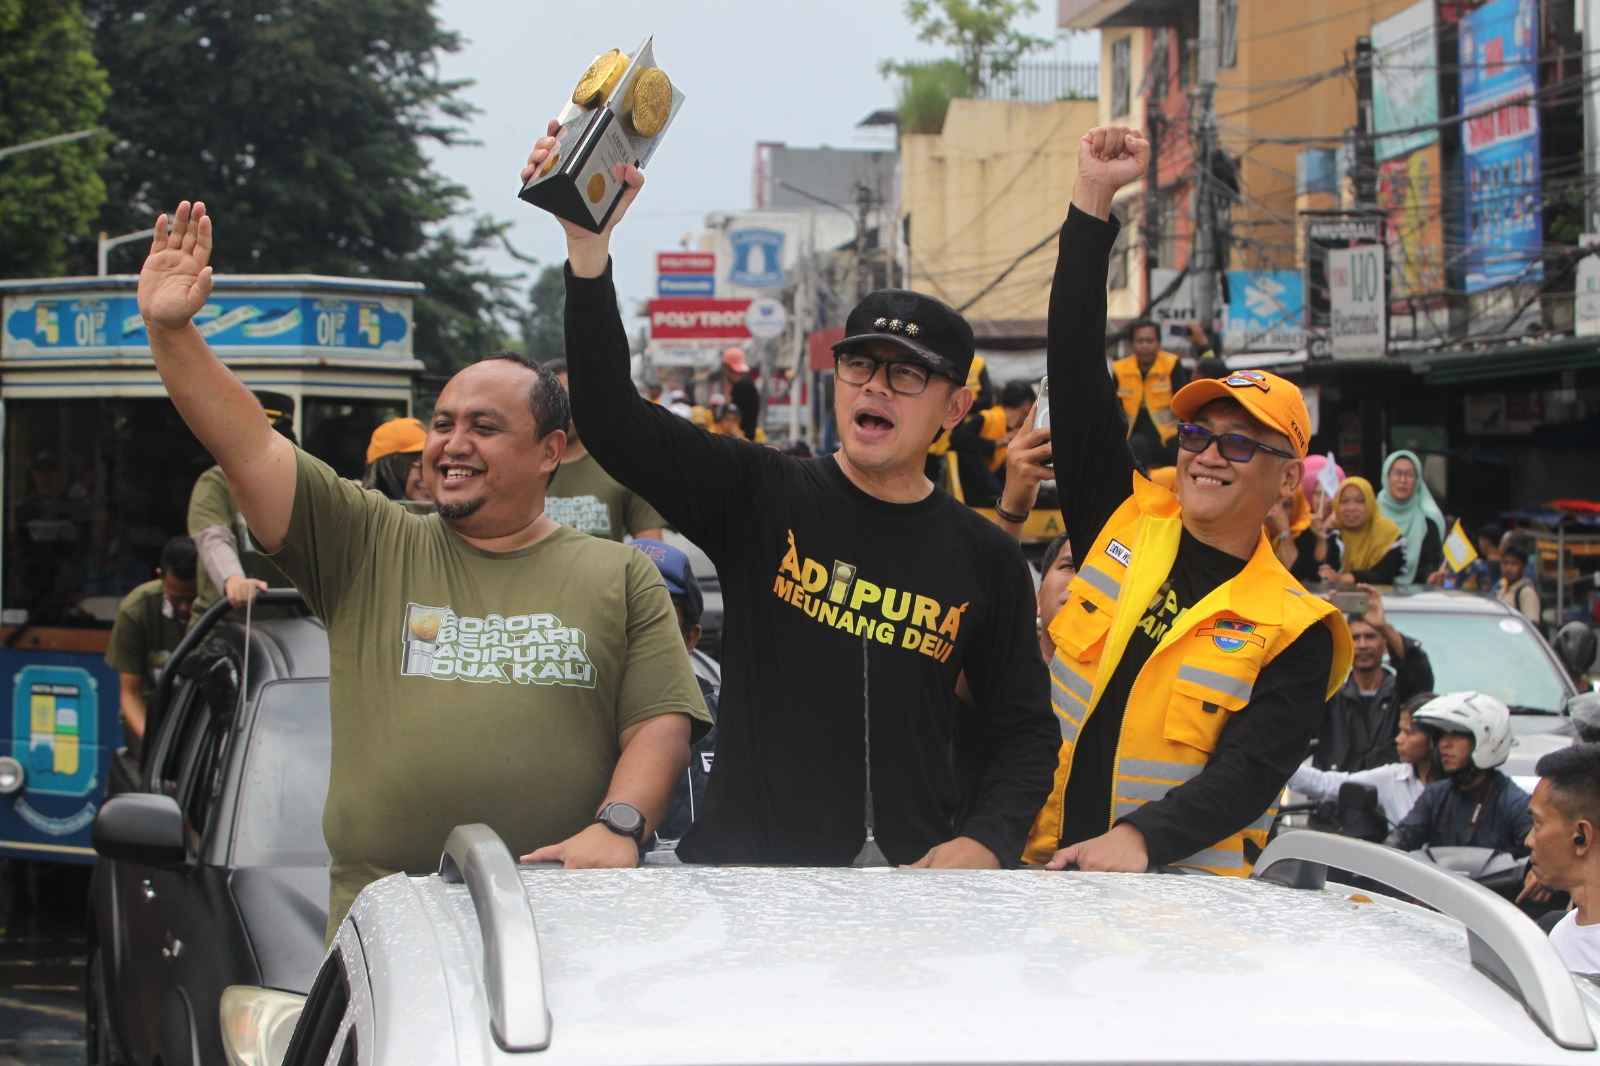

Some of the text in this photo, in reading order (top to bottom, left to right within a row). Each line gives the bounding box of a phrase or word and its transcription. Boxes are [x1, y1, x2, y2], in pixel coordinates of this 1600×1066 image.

[773, 575, 895, 645] MEUNANG
[441, 611, 555, 632] BOGOR
[437, 627, 580, 648] BERLARI
[433, 644, 587, 663] ADIPURA
[430, 659, 592, 682] DUA KALI
